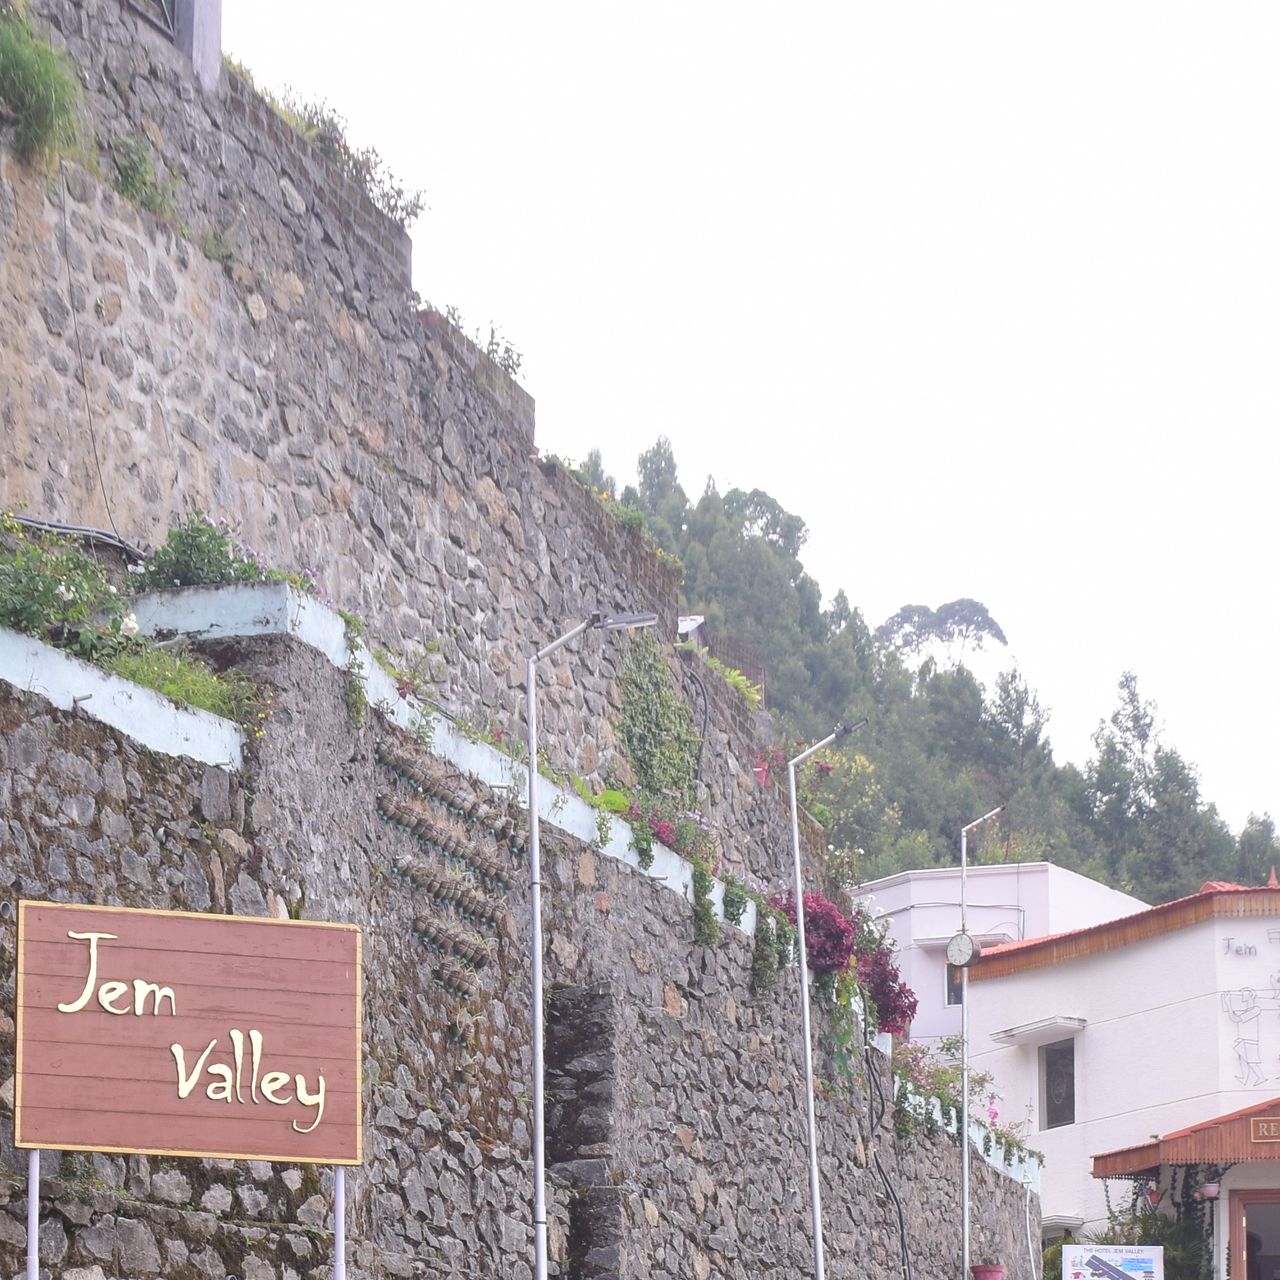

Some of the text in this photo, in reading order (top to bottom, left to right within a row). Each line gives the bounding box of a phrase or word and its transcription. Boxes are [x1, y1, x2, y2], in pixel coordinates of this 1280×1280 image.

[57, 930, 176, 1016] Jem
[1222, 937, 1257, 956] Jem
[170, 1028, 326, 1134] Valley
